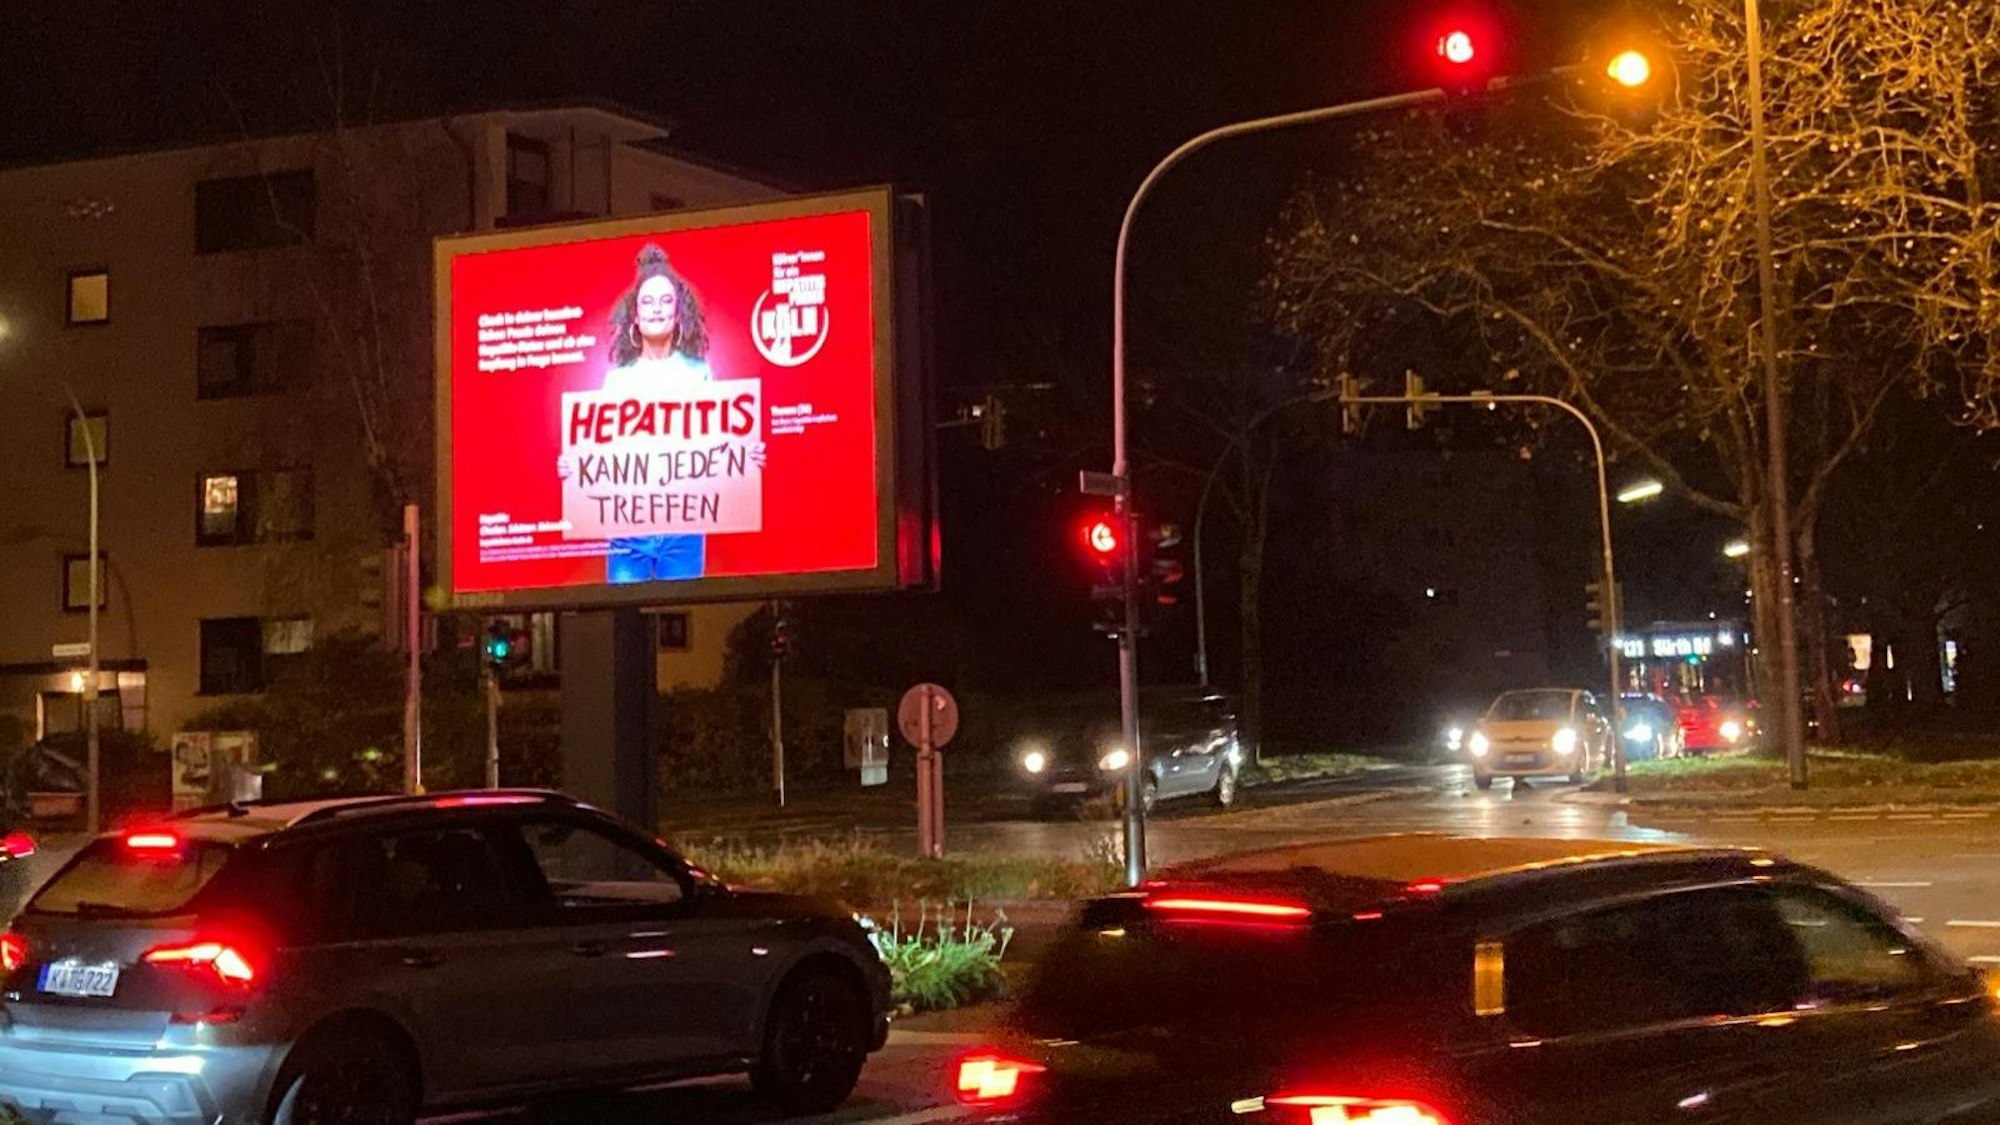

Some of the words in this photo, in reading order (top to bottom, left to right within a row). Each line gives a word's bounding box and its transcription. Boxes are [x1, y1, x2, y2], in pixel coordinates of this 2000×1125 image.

[570, 393, 754, 445] HEPATITIS
[579, 452, 649, 488] KANN
[587, 493, 720, 524] TREFFEN
